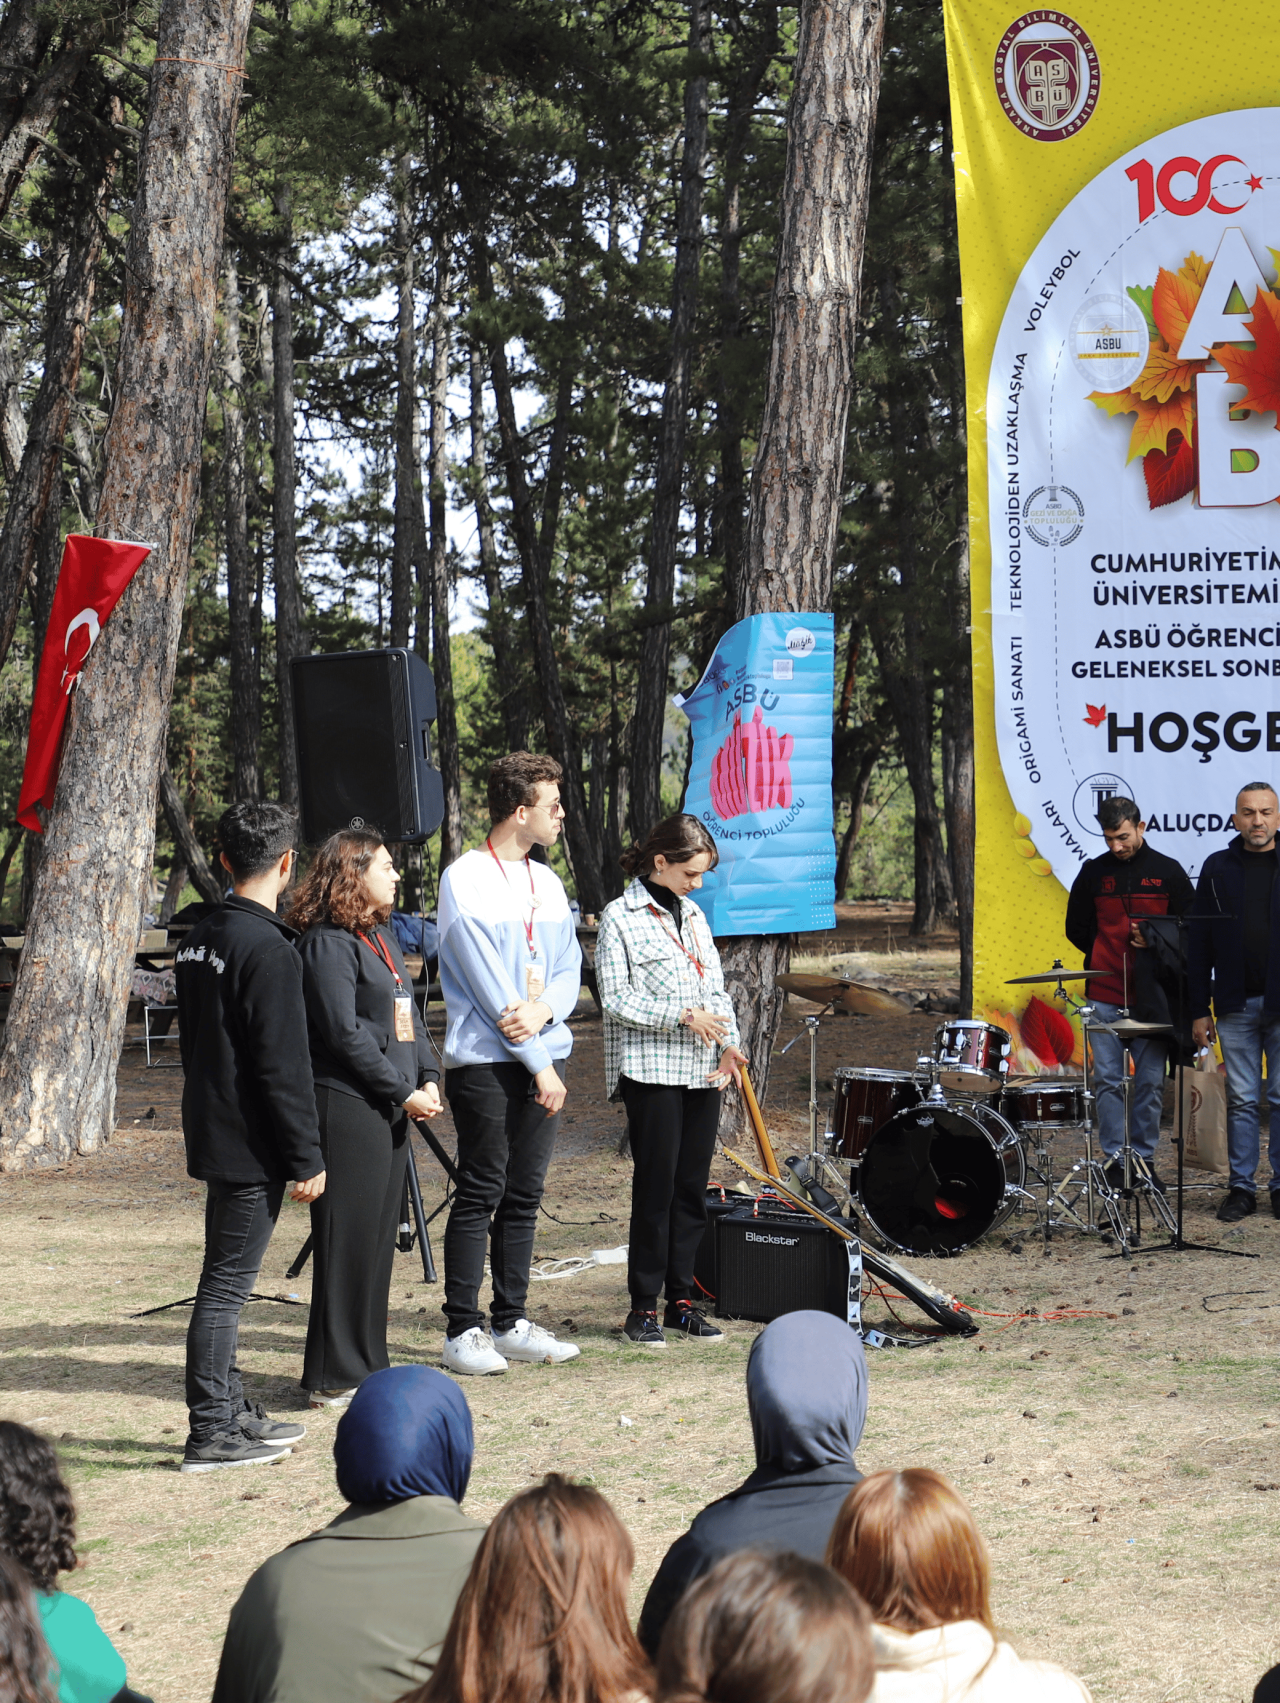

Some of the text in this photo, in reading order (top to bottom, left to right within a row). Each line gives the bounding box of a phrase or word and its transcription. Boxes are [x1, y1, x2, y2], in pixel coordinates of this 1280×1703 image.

[996, 11, 1099, 137] ANKARA SOSYAL BİLİMLER ÜNİVERSİTESİ
[1024, 248, 1081, 332] VOLEYBOL
[1095, 338, 1122, 350] ASBU
[1005, 353, 1028, 612] TEKNOLOJİDEN UZAKLAŞMA
[1030, 509, 1046, 517] GEZİ
[1057, 508, 1078, 517] DOĞA
[1030, 516, 1078, 524] TOPLULUĞU
[1095, 624, 1160, 649] ASBÜ
[1167, 621, 1280, 648] ÖĞRENCİ
[1071, 660, 1217, 679] GELENEKSEL
[725, 683, 781, 722] ASBÜ
[1010, 636, 1041, 784] ORİGAMİ SANATI
[702, 797, 806, 841] ÖĞRENCİ TOPLULUĞU
[1041, 799, 1088, 862] MALARI
[1145, 813, 1240, 837] ALUÇDA
[745, 1231, 798, 1246] Blackstar
